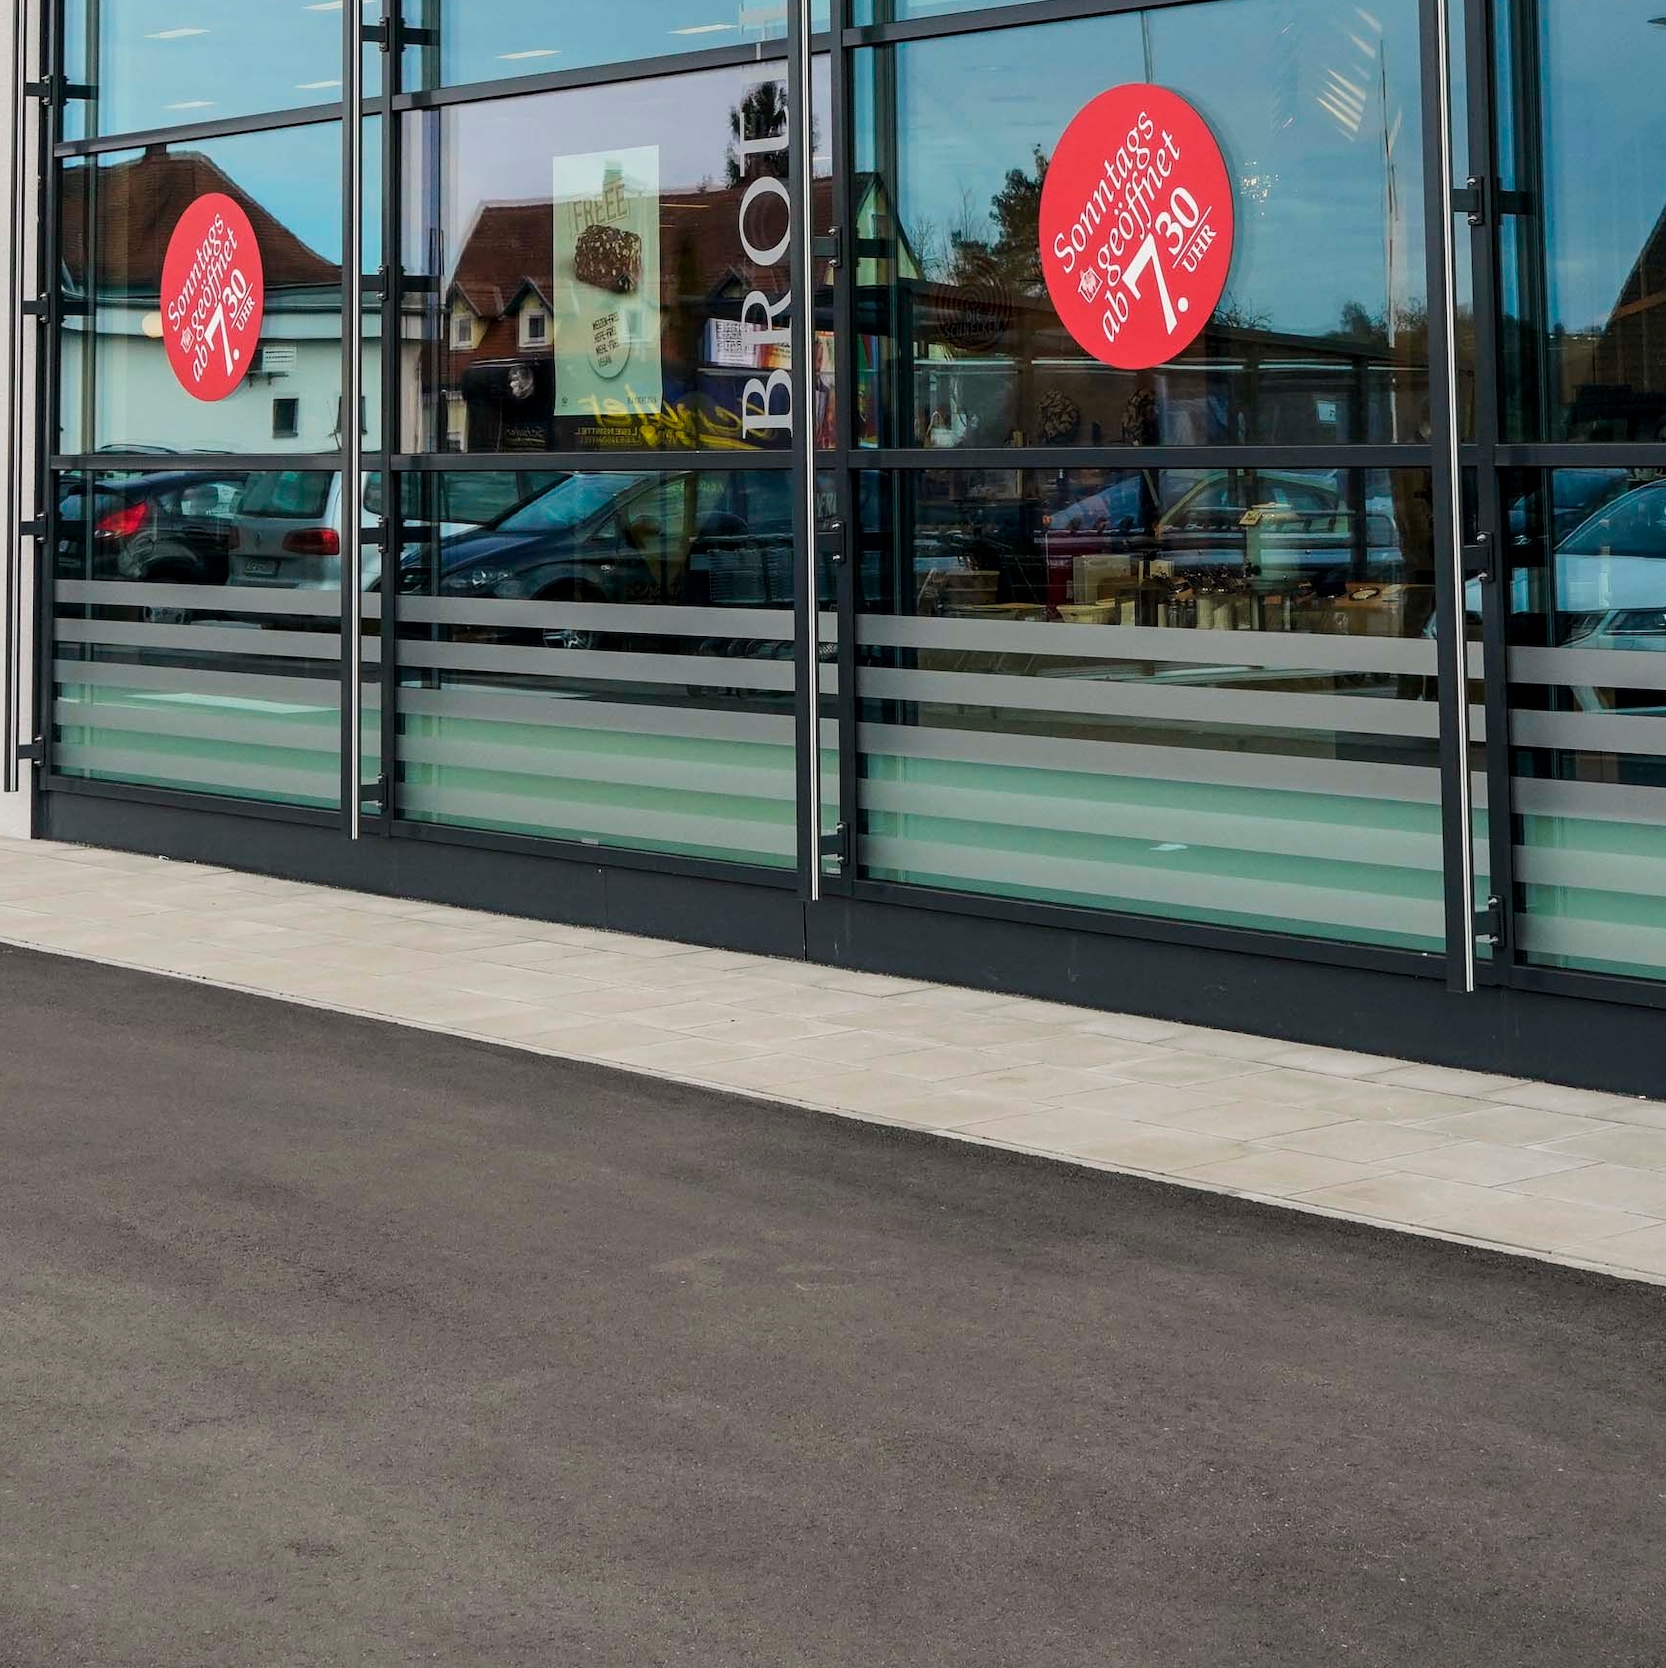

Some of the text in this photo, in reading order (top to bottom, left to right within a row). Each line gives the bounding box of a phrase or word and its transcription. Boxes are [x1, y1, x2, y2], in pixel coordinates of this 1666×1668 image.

[1053, 111, 1154, 274] Sonntags
[1097, 130, 1181, 287] geöffnet
[168, 213, 224, 331] Sonntags
[191, 227, 237, 342] geöffnet
[1182, 224, 1217, 273] UHR
[236, 296, 256, 331] UHR
[1101, 290, 1129, 343] ab
[192, 344, 208, 382] ab
